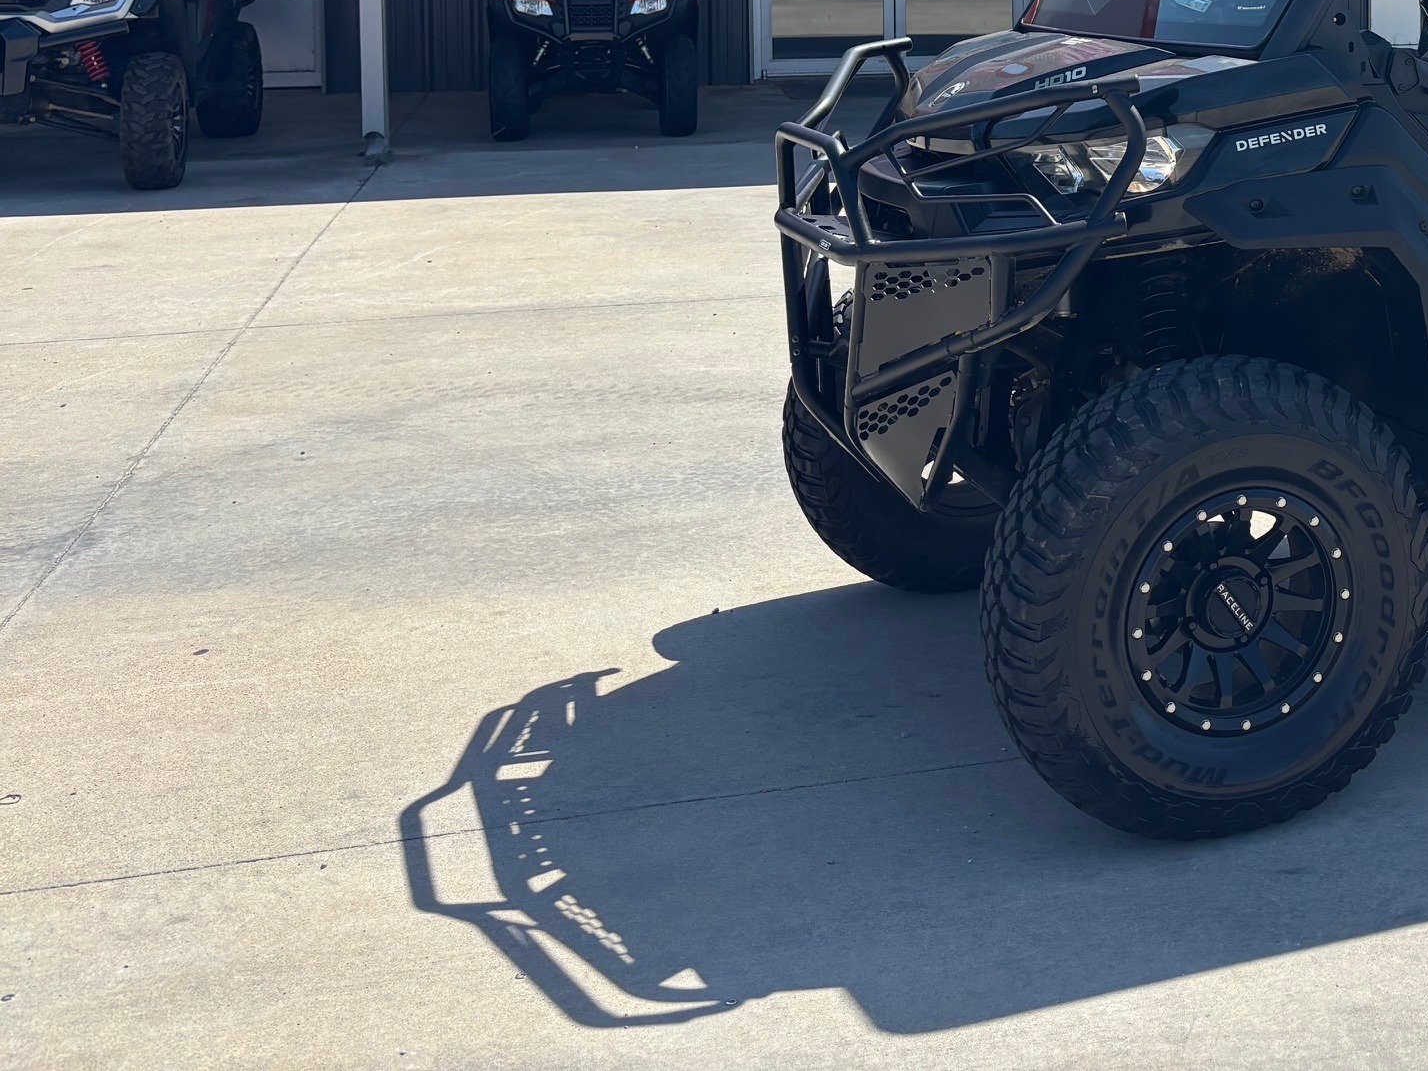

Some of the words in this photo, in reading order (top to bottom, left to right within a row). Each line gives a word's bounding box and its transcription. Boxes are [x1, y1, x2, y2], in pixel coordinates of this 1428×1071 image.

[1034, 66, 1086, 89] HD10
[1235, 124, 1327, 151] DEFENDER
[1217, 583, 1254, 631] RACELINE
[1307, 458, 1396, 727] BFGoodrich
